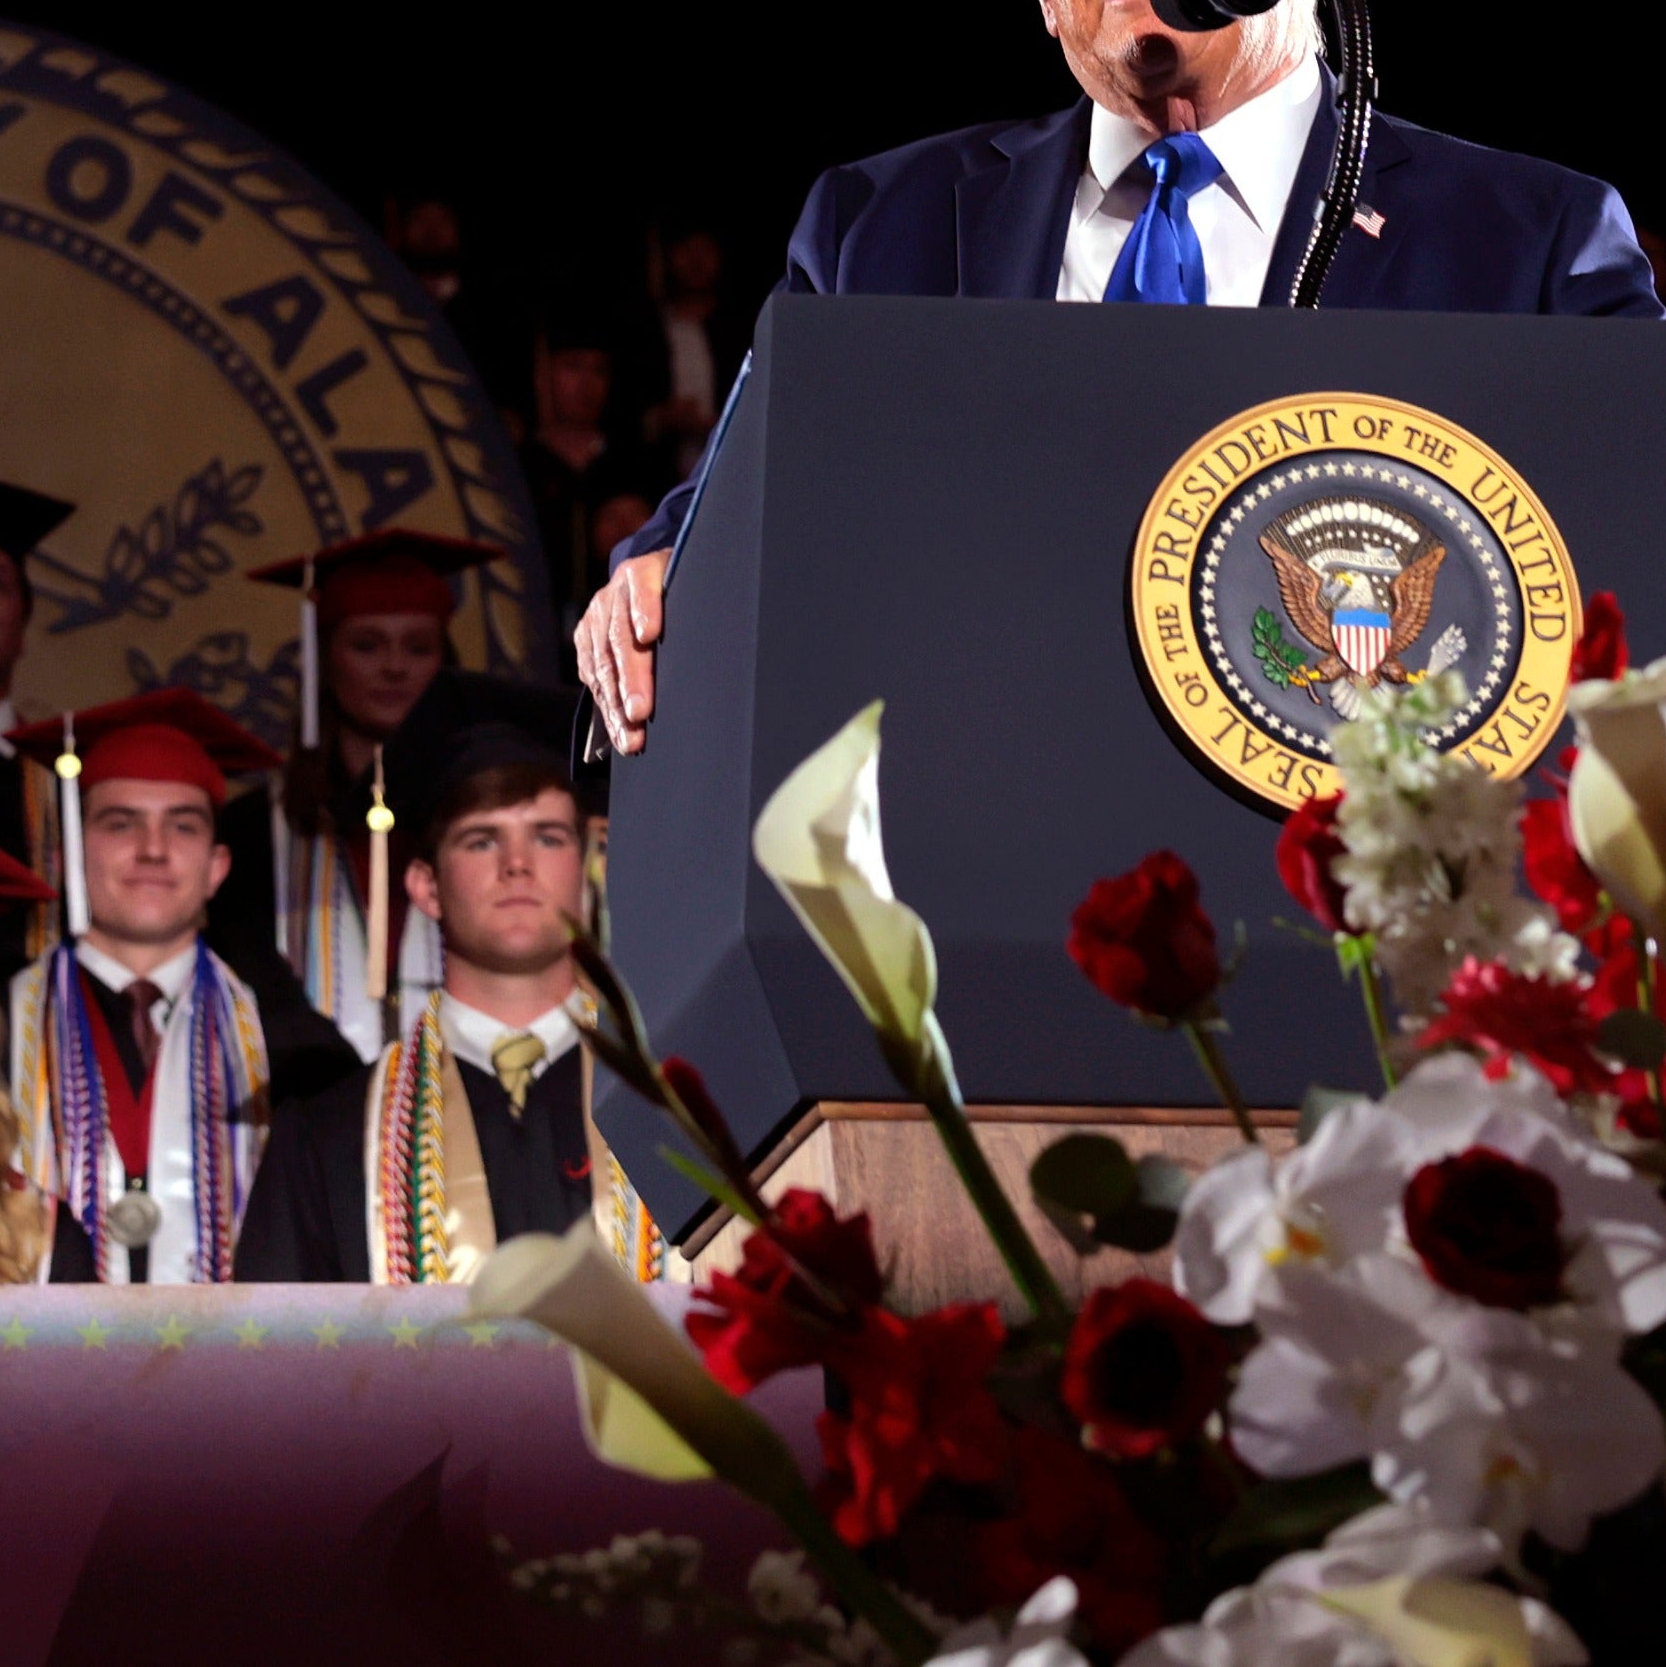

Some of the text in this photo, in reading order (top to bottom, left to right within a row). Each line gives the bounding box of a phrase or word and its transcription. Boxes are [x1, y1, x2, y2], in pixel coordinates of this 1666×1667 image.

[45, 133, 231, 250] OF
[222, 271, 437, 529] ALA
[1353, 415, 1394, 441] OF
[1404, 426, 1459, 469] THE
[1148, 408, 1338, 587] PRESIDENT
[1470, 466, 1568, 644] UNITED
[1155, 603, 1188, 663] THE
[1174, 670, 1209, 708] OF
[1210, 706, 1324, 800] SEAL
